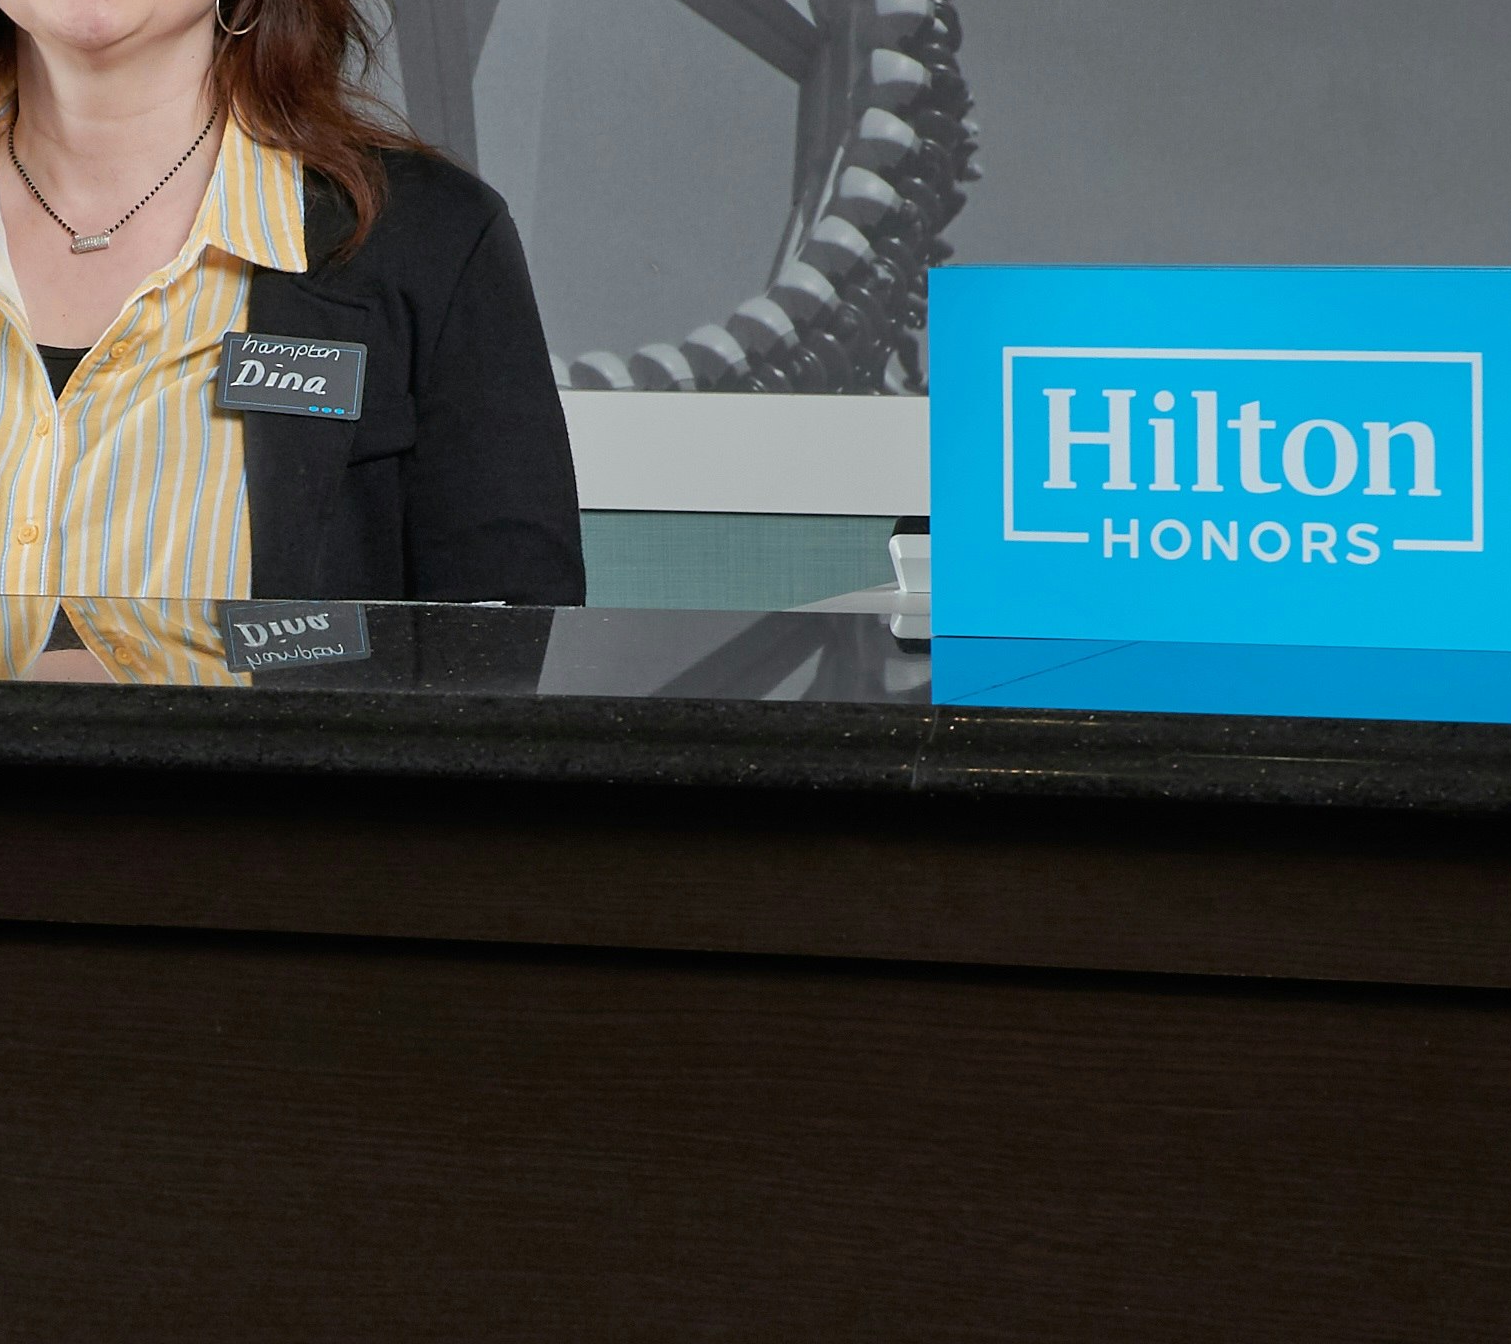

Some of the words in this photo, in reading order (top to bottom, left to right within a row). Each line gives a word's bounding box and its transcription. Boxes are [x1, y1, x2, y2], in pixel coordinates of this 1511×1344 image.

[241, 334, 341, 362] hampton
[230, 359, 327, 395] Dina
[1042, 387, 1442, 497] Hilton
[1102, 517, 1381, 565] HONORS
